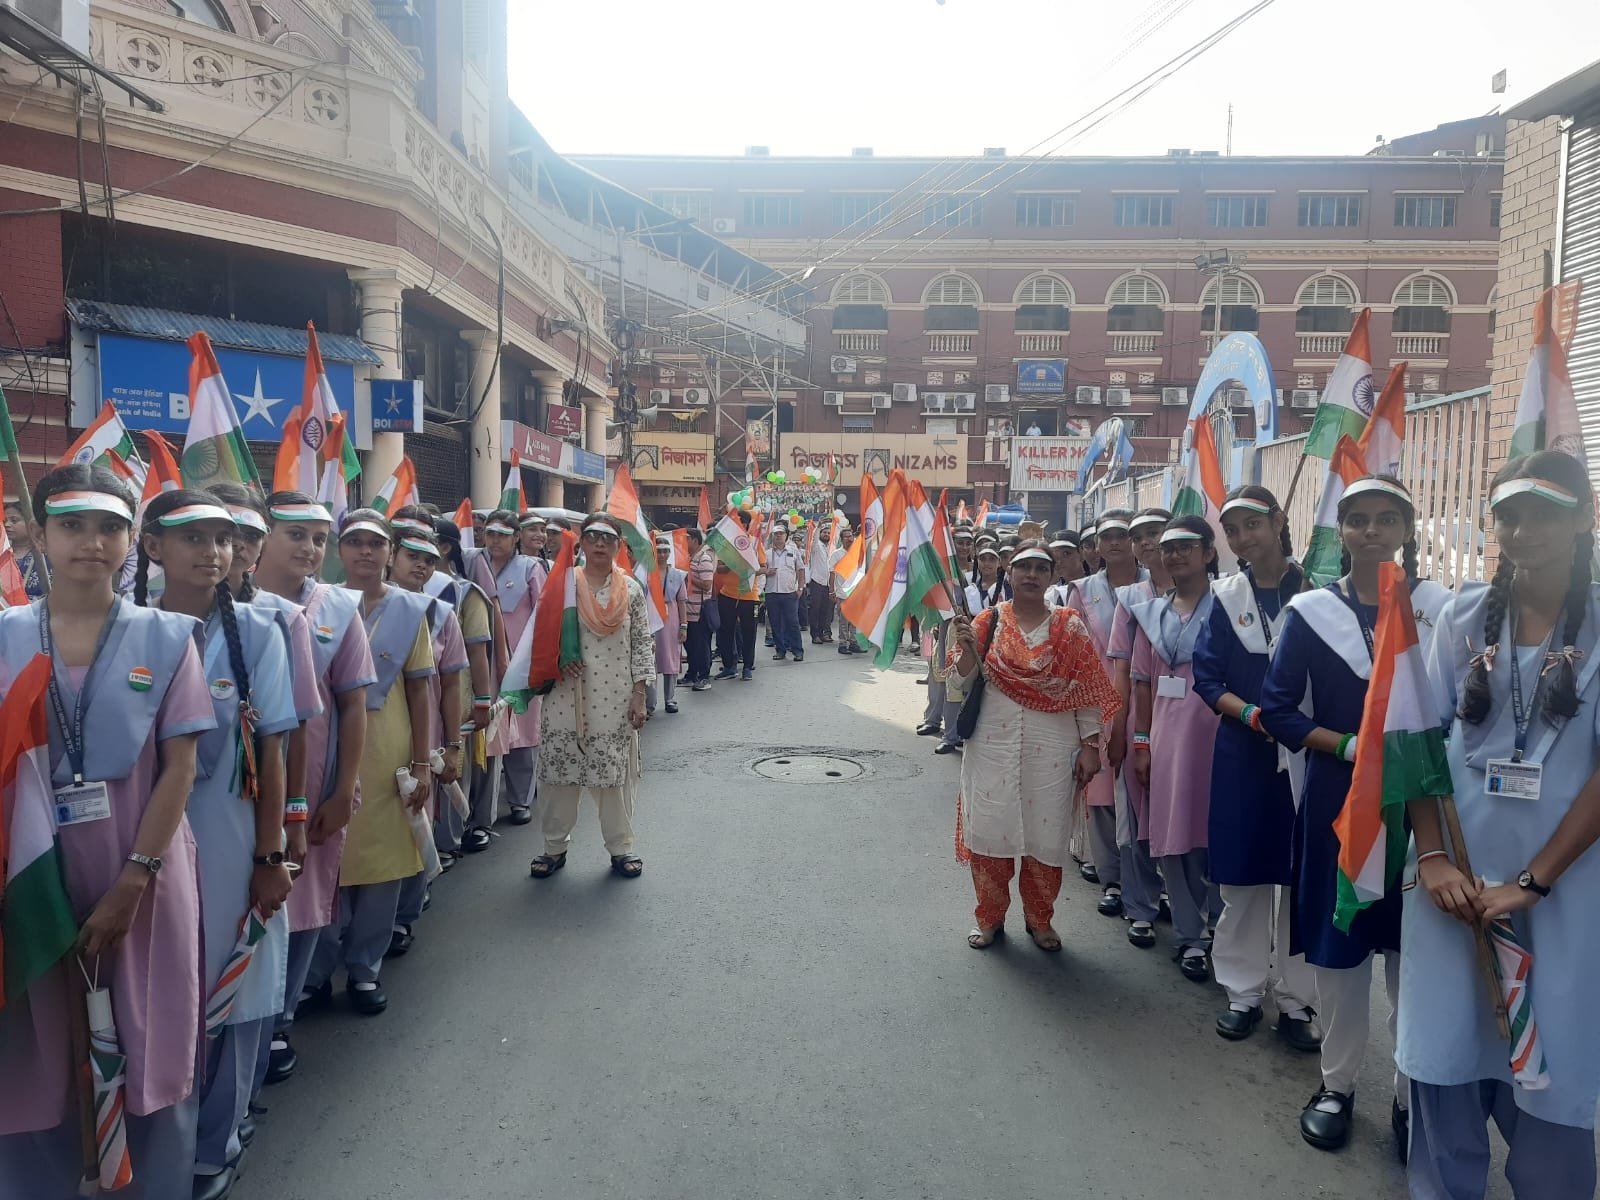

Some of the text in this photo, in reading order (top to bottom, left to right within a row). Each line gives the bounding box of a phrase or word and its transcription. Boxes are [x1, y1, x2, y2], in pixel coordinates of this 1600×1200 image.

[118, 407, 162, 418] ank of India
[373, 418, 391, 429] BOI
[661, 446, 707, 466] নিজামস
[1018, 446, 1067, 459] KILLER
[894, 455, 958, 471] NIZAMS
[642, 487, 701, 498] NIZAM
